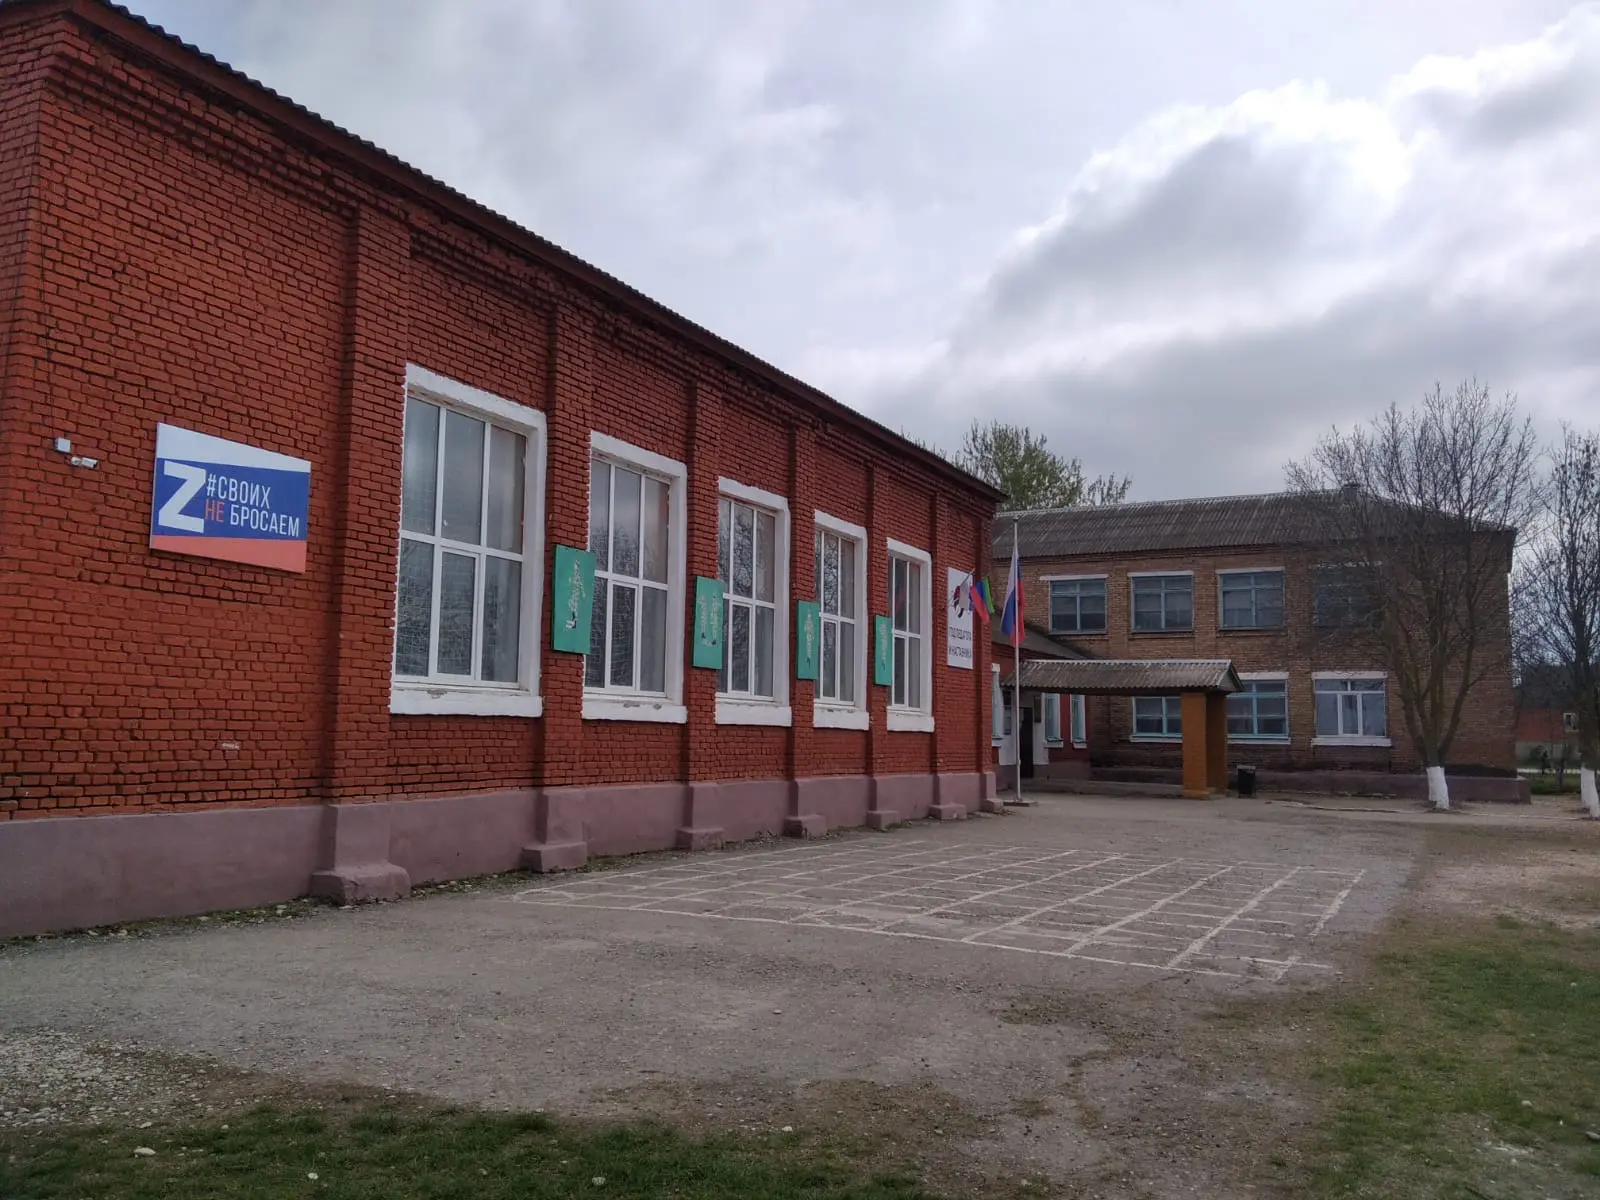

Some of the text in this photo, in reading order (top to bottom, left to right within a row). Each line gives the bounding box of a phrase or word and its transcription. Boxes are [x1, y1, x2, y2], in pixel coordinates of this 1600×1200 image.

[158, 460, 206, 533] Z
[206, 473, 271, 509] #СВОИХ
[205, 499, 300, 537] НЕ БРОСАЕМ
